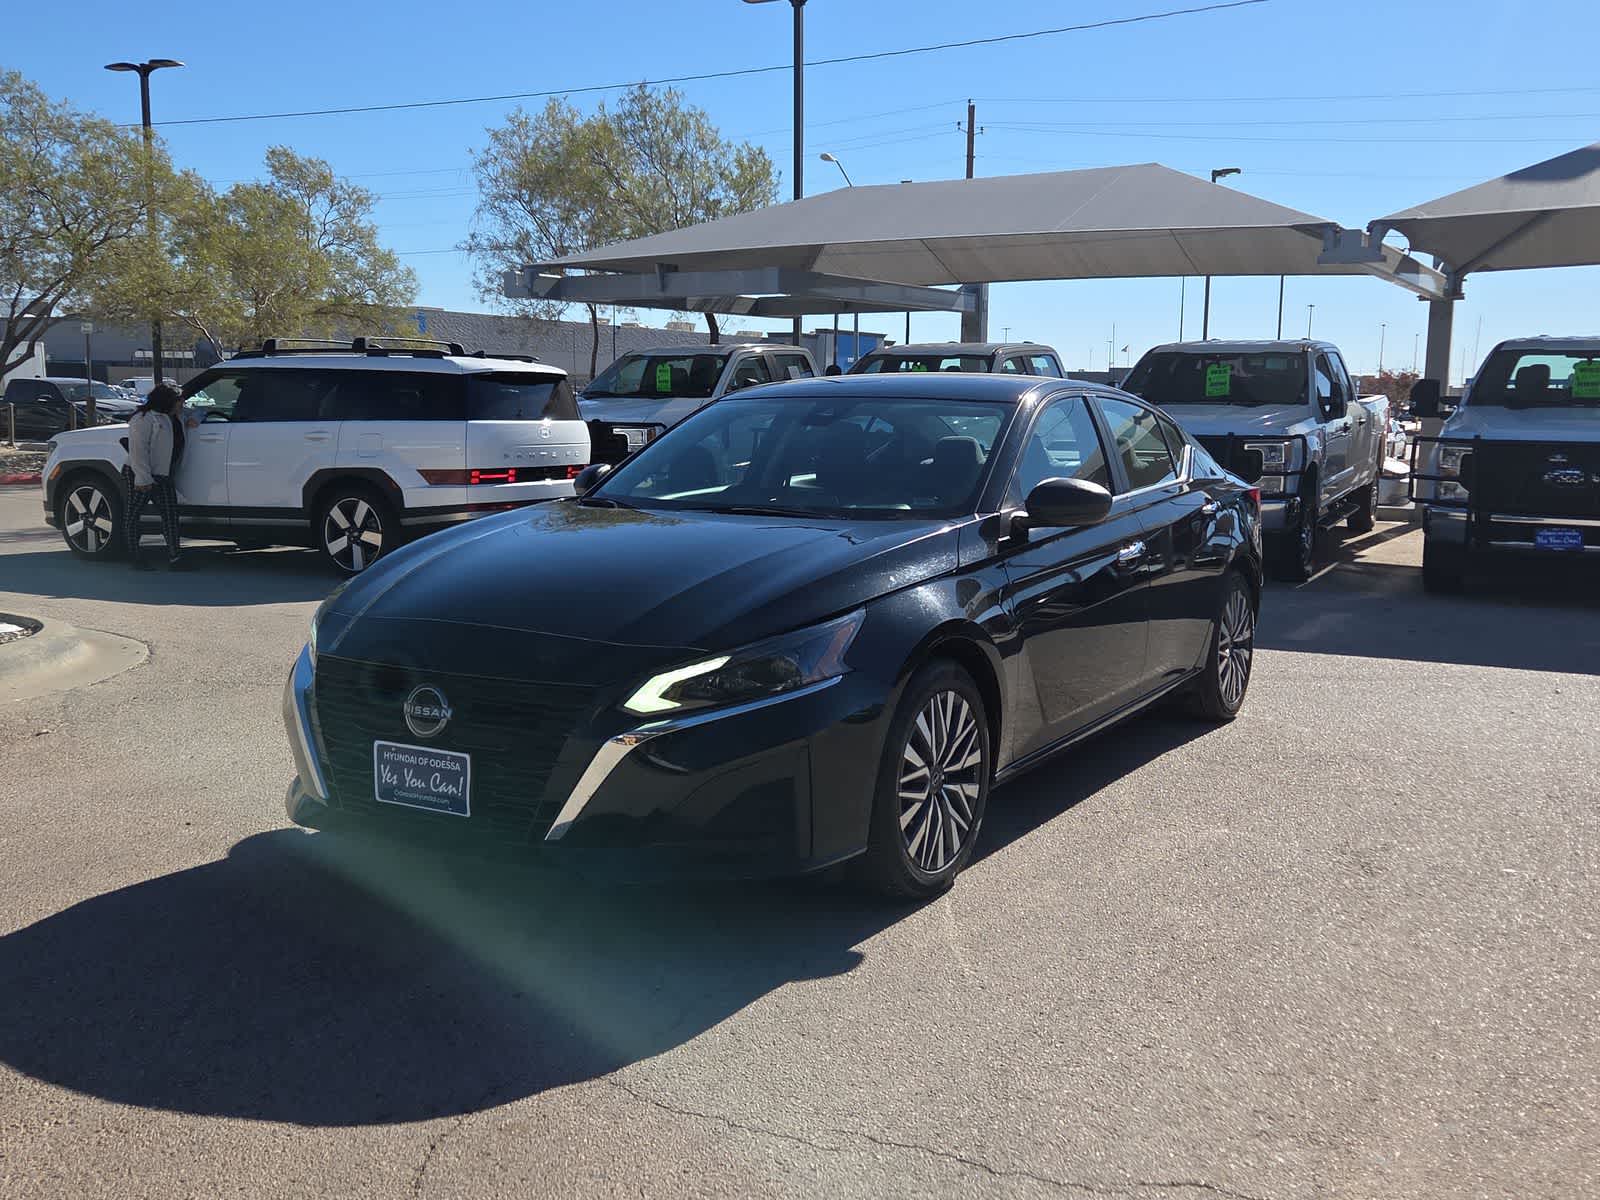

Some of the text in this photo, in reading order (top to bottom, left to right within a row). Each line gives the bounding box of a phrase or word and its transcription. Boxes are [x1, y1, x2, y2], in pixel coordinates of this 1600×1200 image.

[403, 701, 453, 719] NISSAN
[383, 751, 461, 772] HYUNDAI OF ODESSA
[380, 764, 464, 796] Yes You Can!
